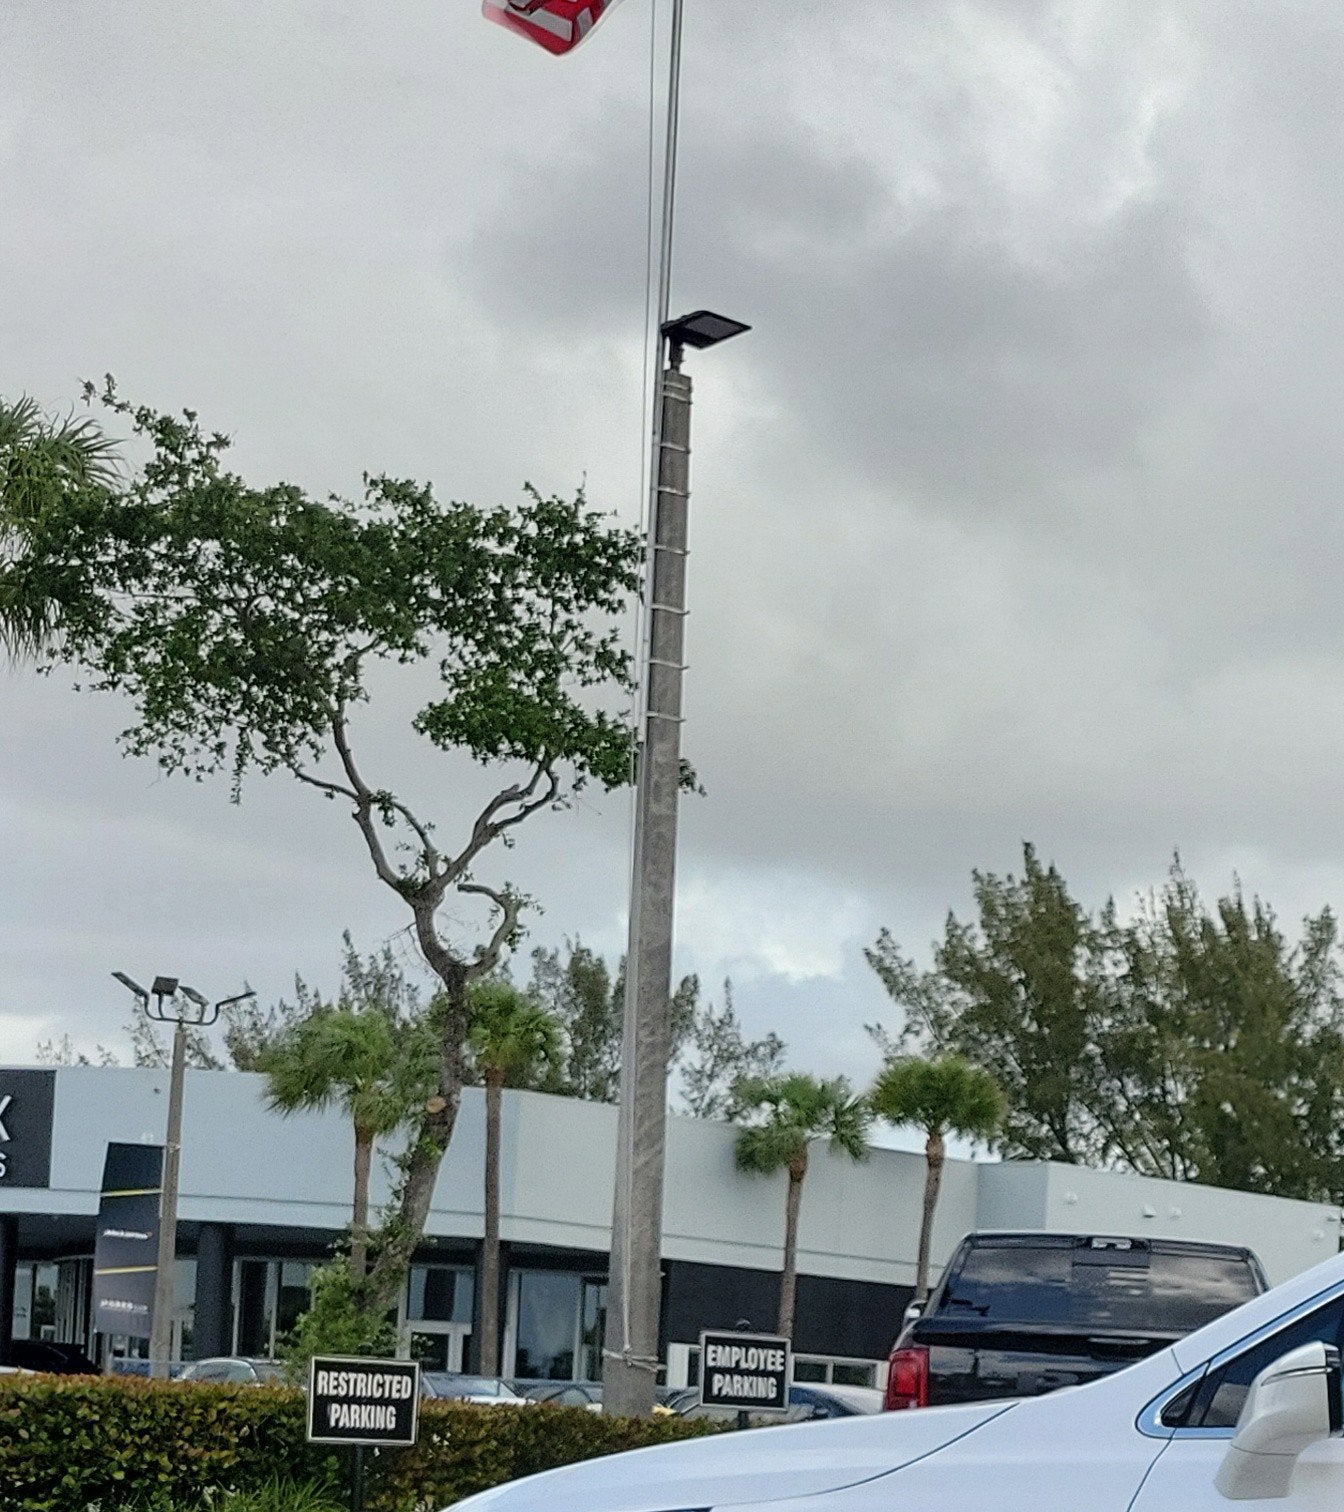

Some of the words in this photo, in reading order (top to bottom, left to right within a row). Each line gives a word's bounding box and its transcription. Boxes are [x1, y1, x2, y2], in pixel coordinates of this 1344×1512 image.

[706, 1344, 785, 1372] EMPLOYEE
[316, 1370, 412, 1399] RESTRICTED
[712, 1373, 778, 1400] PARKING
[329, 1403, 397, 1430] PARKING
